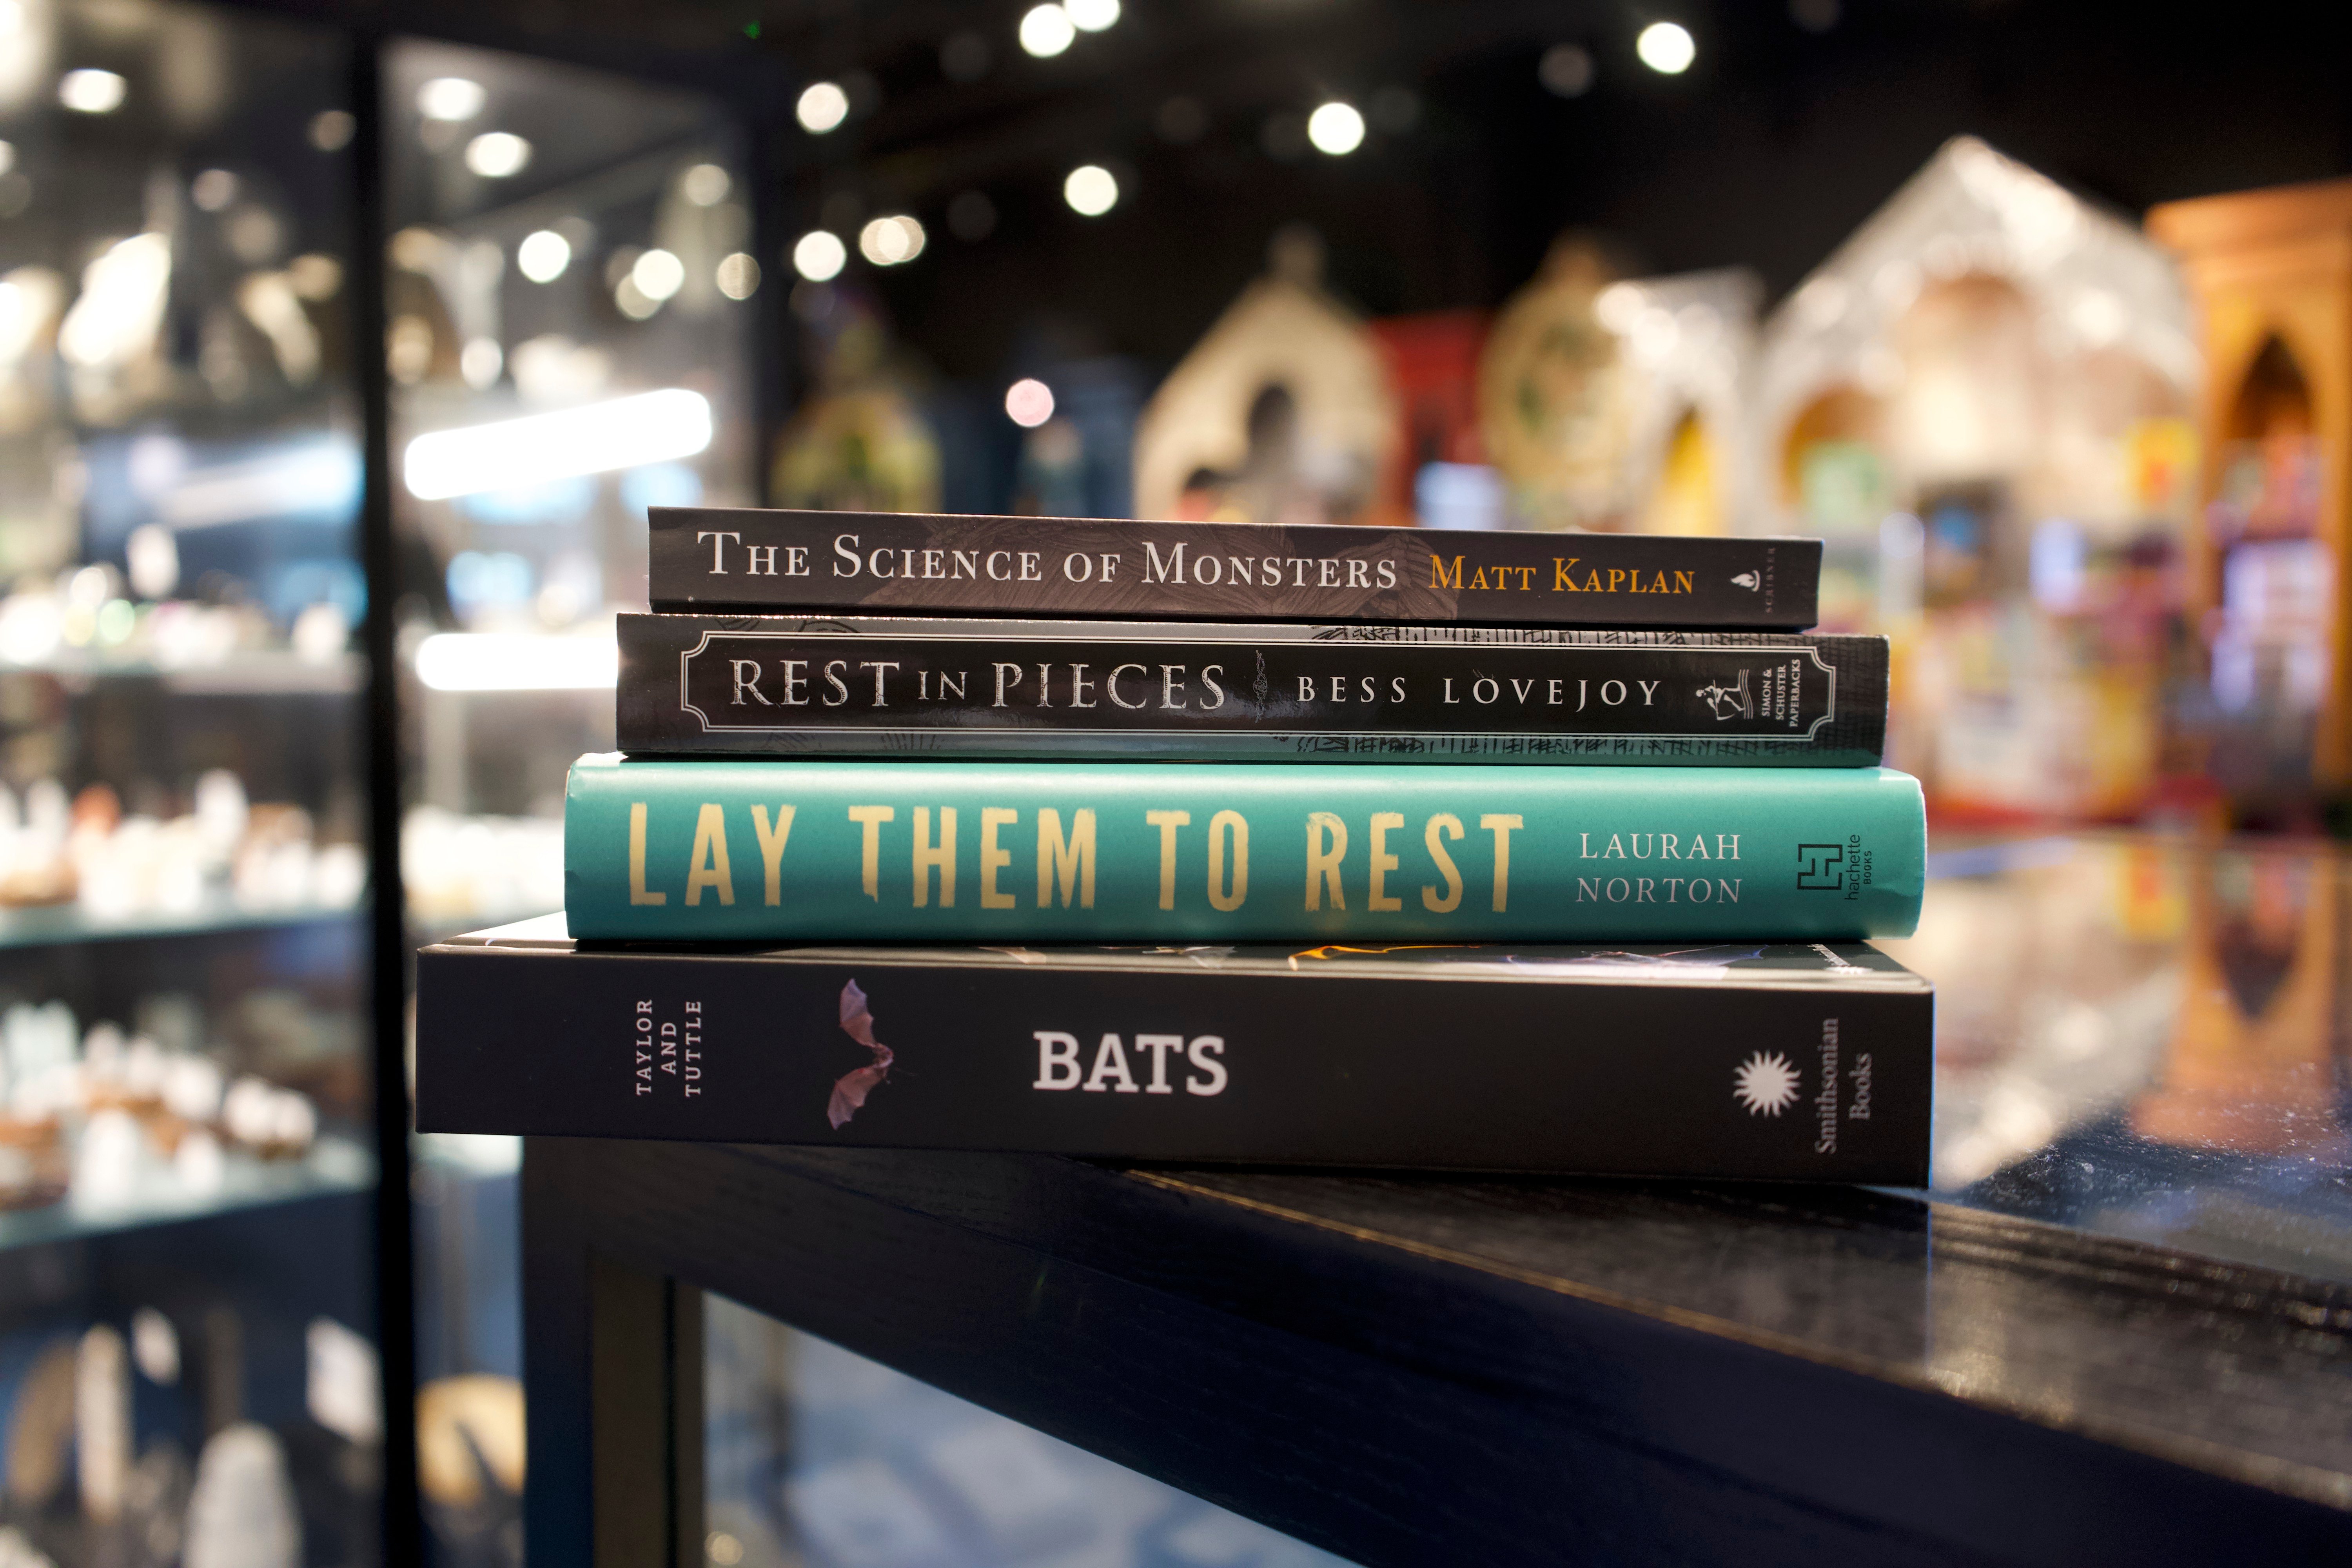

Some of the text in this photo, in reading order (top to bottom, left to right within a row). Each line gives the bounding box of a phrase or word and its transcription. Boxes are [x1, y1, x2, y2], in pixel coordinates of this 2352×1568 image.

[697, 531, 1396, 589] THE SCIENCE OF MONSTERS
[1428, 554, 1695, 593] MATT KAPLAN
[1766, 548, 1775, 613] SCRIBNER
[728, 659, 1224, 710] REST IN PIECES
[1297, 676, 1661, 712] BESS LOVEJOY
[1762, 668, 1772, 717] SIMON &
[1776, 664, 1786, 720] SCHUSTER
[1789, 659, 1801, 727] PAPERBACKS
[629, 802, 1524, 912] LAY THEM TO REST
[1580, 833, 1740, 860] LAURAH
[1844, 834, 1860, 900] hachette
[1864, 851, 1872, 885] BOOKS
[1576, 877, 1742, 903] NORTON
[636, 999, 652, 1096] TAYLOR
[661, 1022, 677, 1076] AND
[685, 1001, 701, 1097] TUTTLE
[1033, 1031, 1227, 1096] BATS
[1815, 1018, 1838, 1154] Smithsonian
[1848, 1053, 1872, 1120] Books
